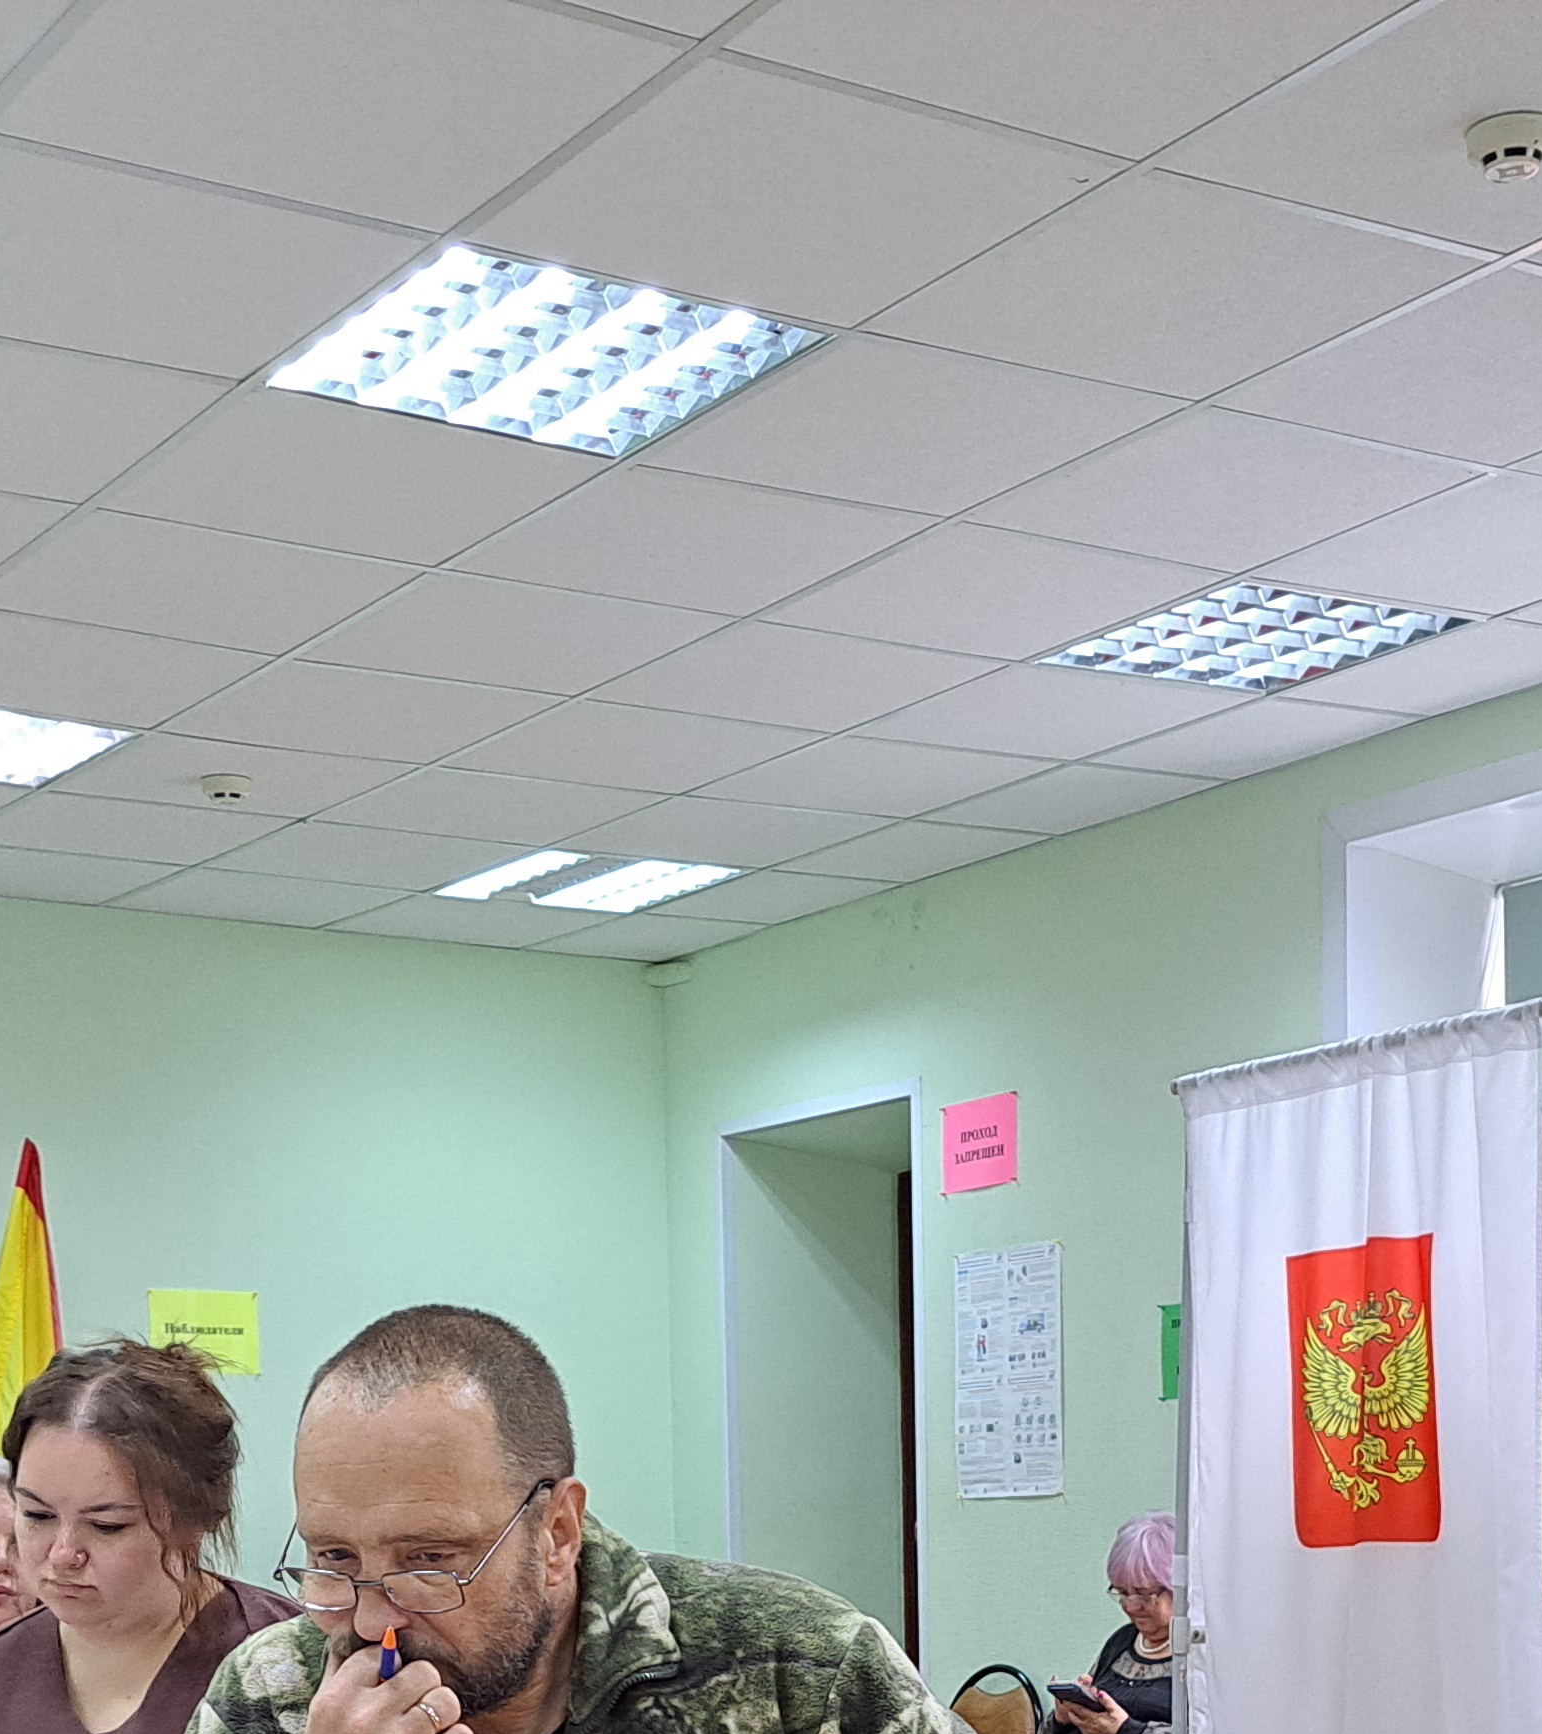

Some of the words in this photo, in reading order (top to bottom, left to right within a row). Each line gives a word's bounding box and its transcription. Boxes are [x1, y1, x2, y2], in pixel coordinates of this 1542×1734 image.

[960, 1125, 998, 1143] ПРОХОД
[954, 1144, 1004, 1165] ЗАПРЕЩЕН
[164, 1322, 244, 1335] Наблюдатели
